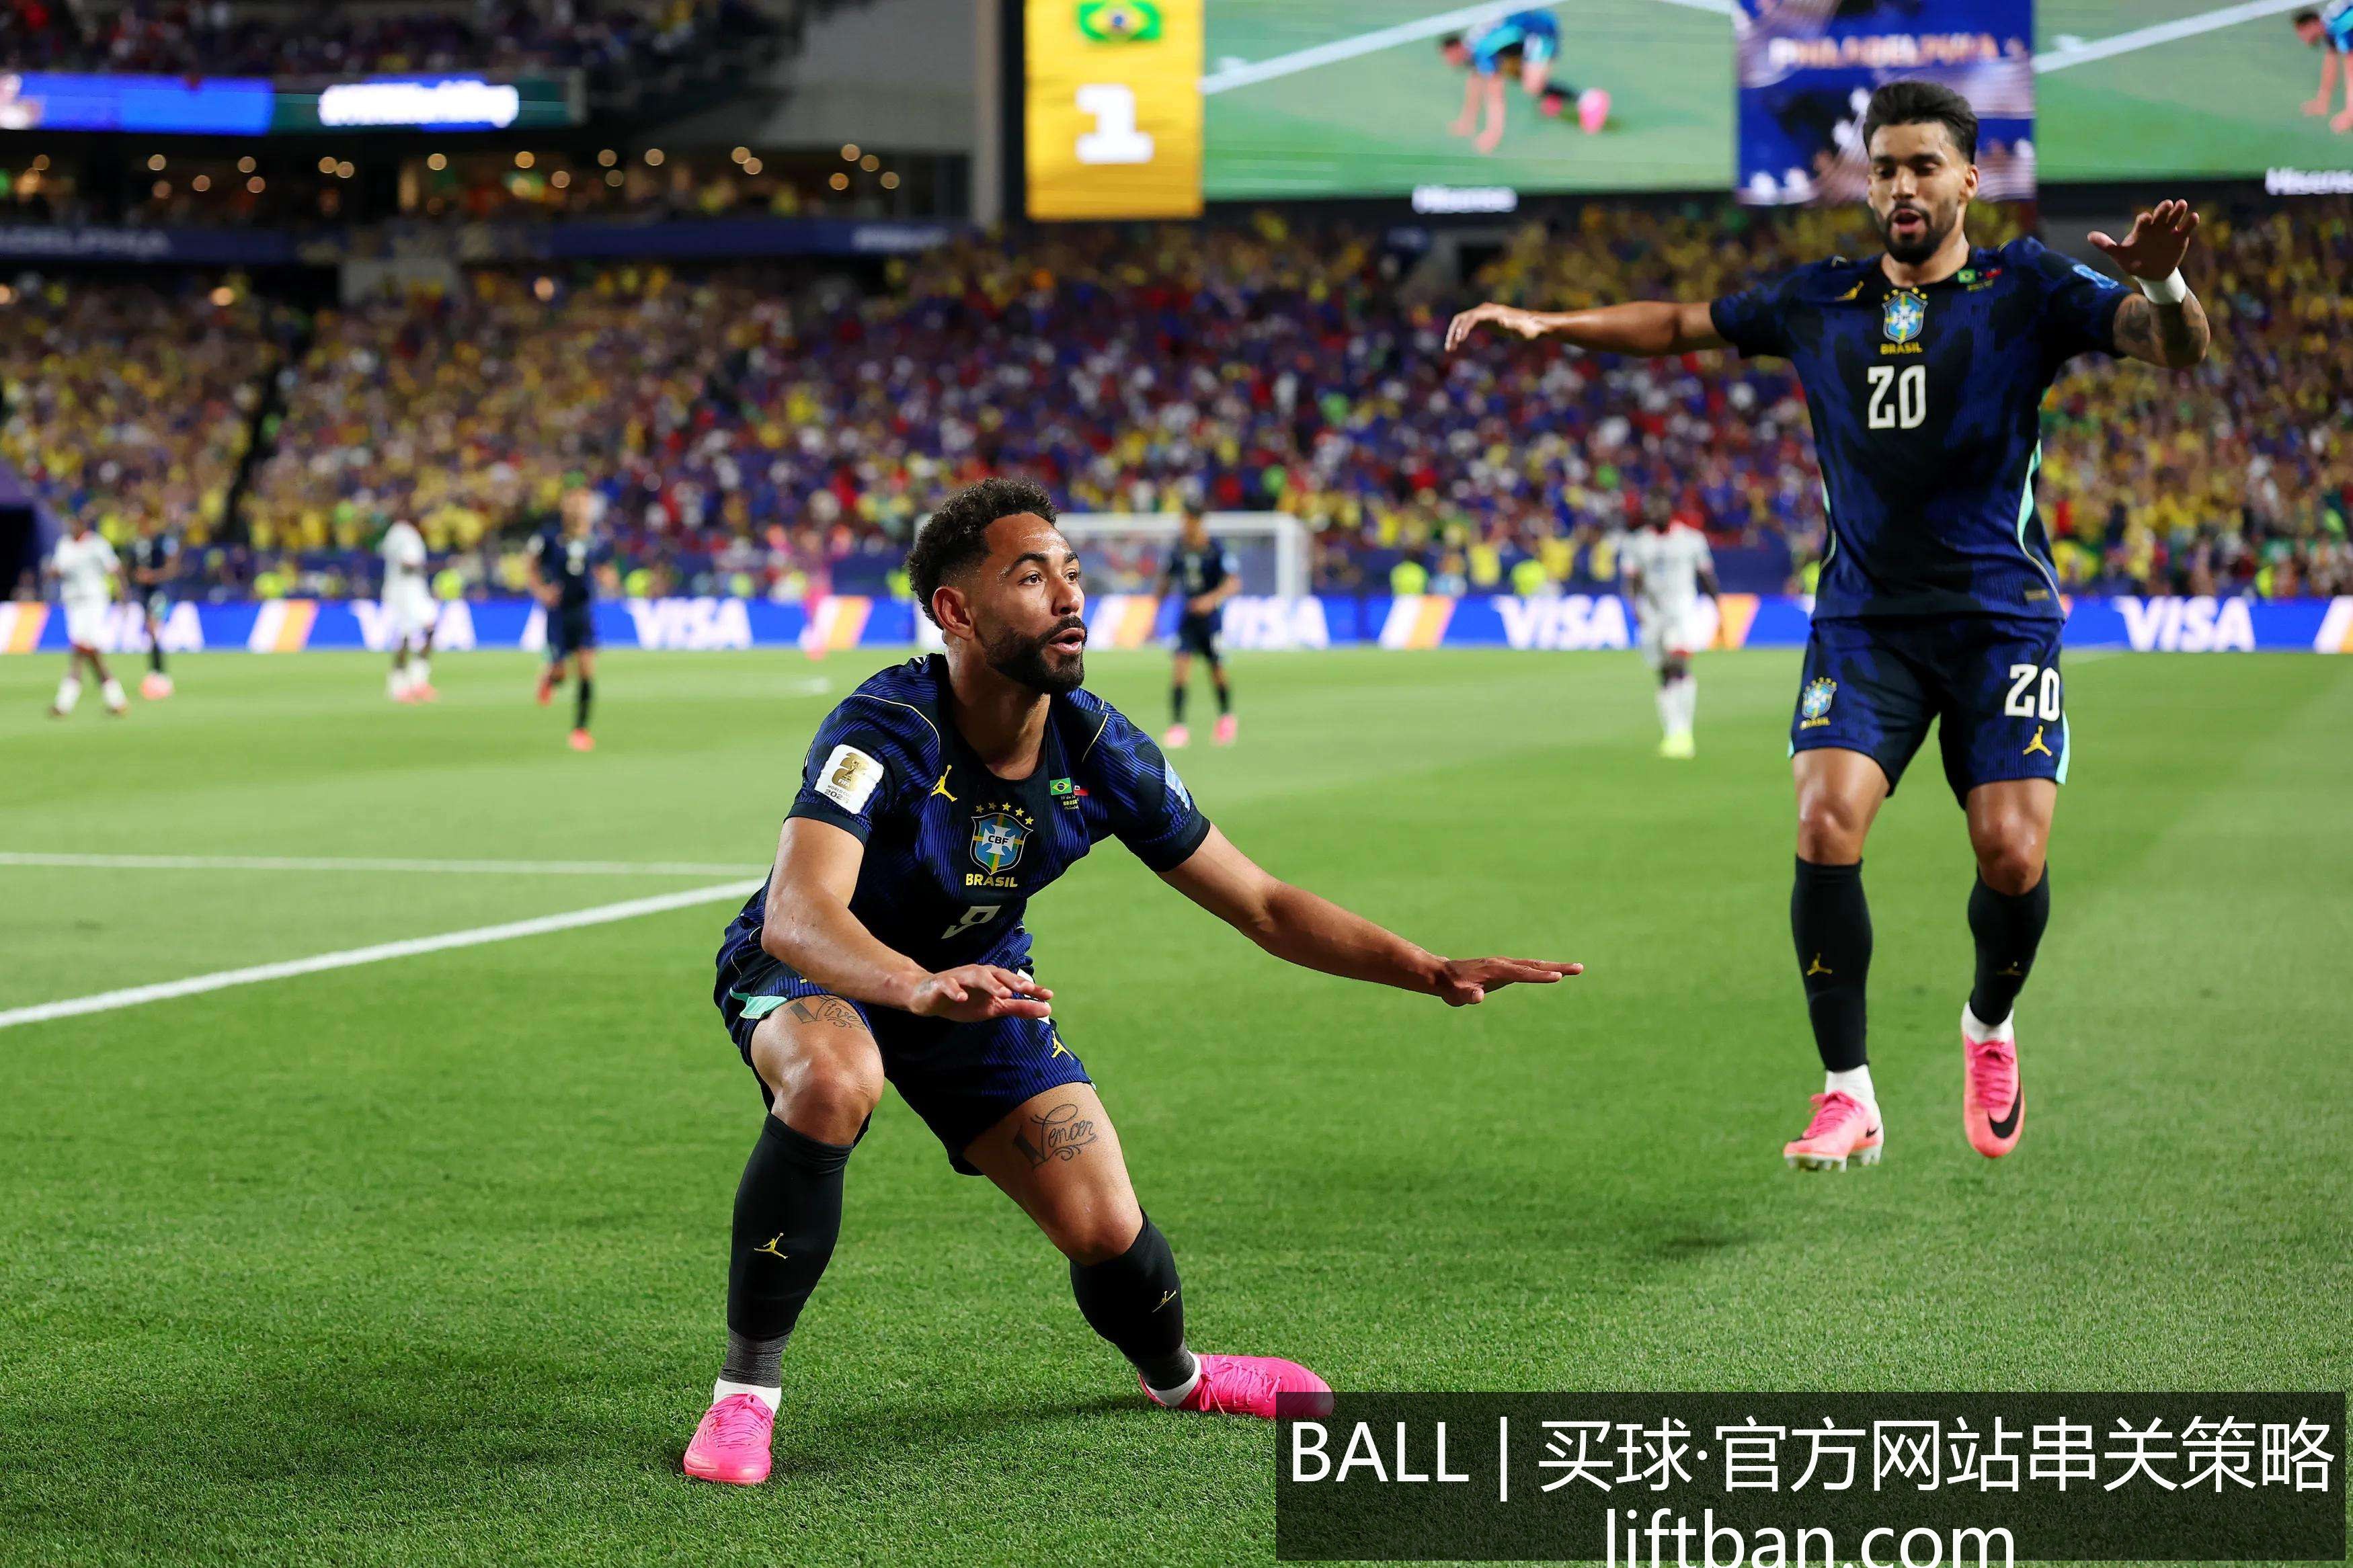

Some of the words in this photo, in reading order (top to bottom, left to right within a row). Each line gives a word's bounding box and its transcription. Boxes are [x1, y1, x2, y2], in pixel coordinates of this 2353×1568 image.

[1075, 84, 1154, 164] 1
[1880, 341, 1923, 355] BRASIL
[1868, 365, 1927, 429] 20
[1492, 595, 1630, 650] VISA
[2112, 595, 2257, 652] VISA
[2005, 663, 2060, 722] 20
[827, 784, 843, 794] WORLD
[838, 778, 850, 788] FIFA
[988, 835, 1009, 845] CBF
[965, 874, 1019, 887] BRASIL
[941, 905, 1002, 939] 9
